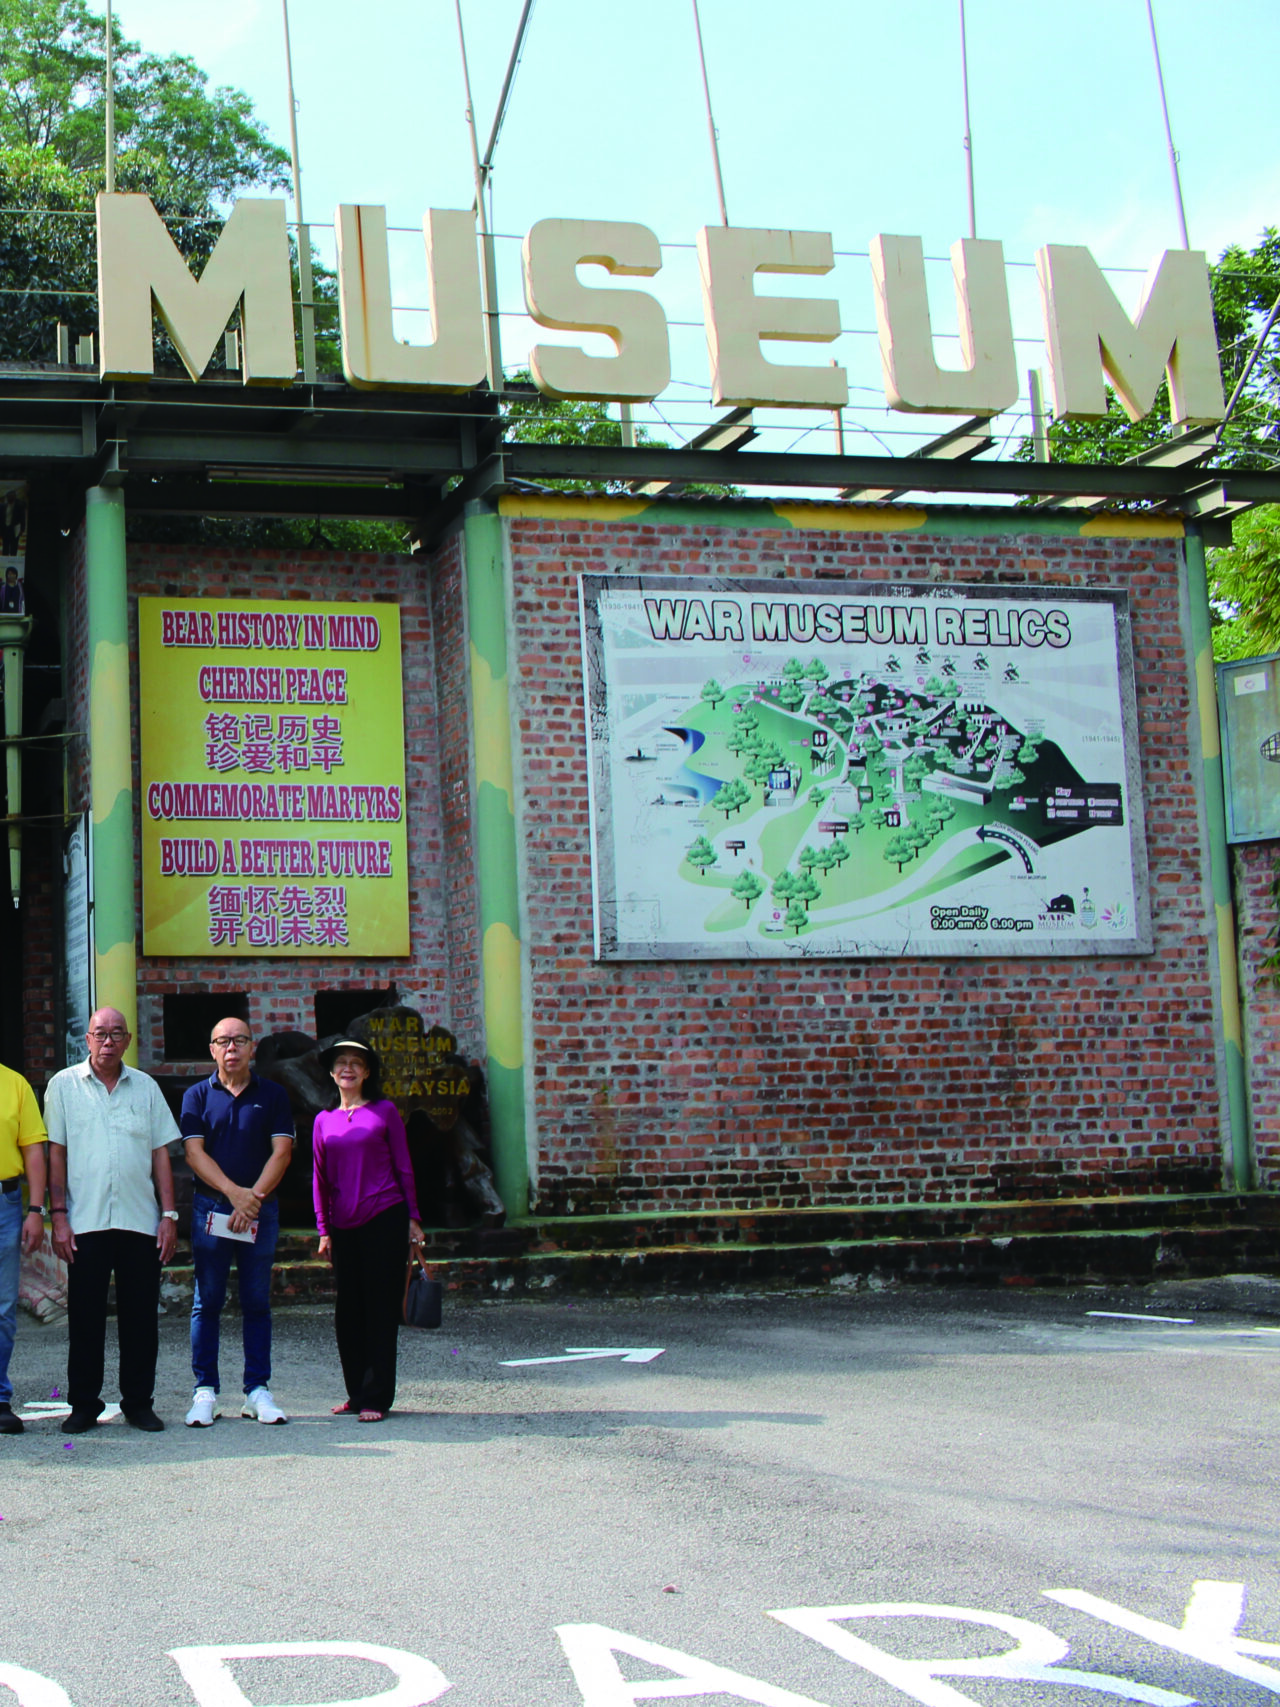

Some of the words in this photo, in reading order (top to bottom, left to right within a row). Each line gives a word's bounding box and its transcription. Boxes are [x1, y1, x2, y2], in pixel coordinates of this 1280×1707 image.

[96, 191, 1224, 427] MUSEUM
[161, 611, 214, 646] BEAR
[218, 612, 301, 648] HISTORY
[303, 614, 325, 649] IN
[328, 615, 379, 649] MIND
[643, 599, 744, 641] WAR
[752, 604, 929, 645] MUSEUM
[937, 607, 1071, 648] RELICS
[199, 666, 282, 702] CHERISH
[286, 668, 346, 702] PEACE
[205, 712, 342, 742] 铭记历史
[205, 741, 344, 772] 珍爱和平
[148, 783, 304, 821] COMMEMORATE
[307, 784, 401, 821] MARTYRS
[1055, 787, 1072, 797] Key
[160, 839, 218, 875] BUILD
[222, 840, 236, 874] A
[240, 840, 312, 875] BETTER
[317, 840, 391, 876] FUTURE
[208, 885, 347, 915] 缅怀先烈
[930, 907, 960, 919] Open
[961, 906, 988, 919] Daily
[209, 914, 348, 946] 开创未来
[932, 919, 955, 930] 9.00
[957, 920, 974, 929] am
[974, 920, 988, 929] to
[990, 919, 1014, 930] 6.00
[1015, 920, 1033, 931] pm
[369, 1017, 419, 1032] WAR
[382, 1079, 471, 1096] ALAYSIA
